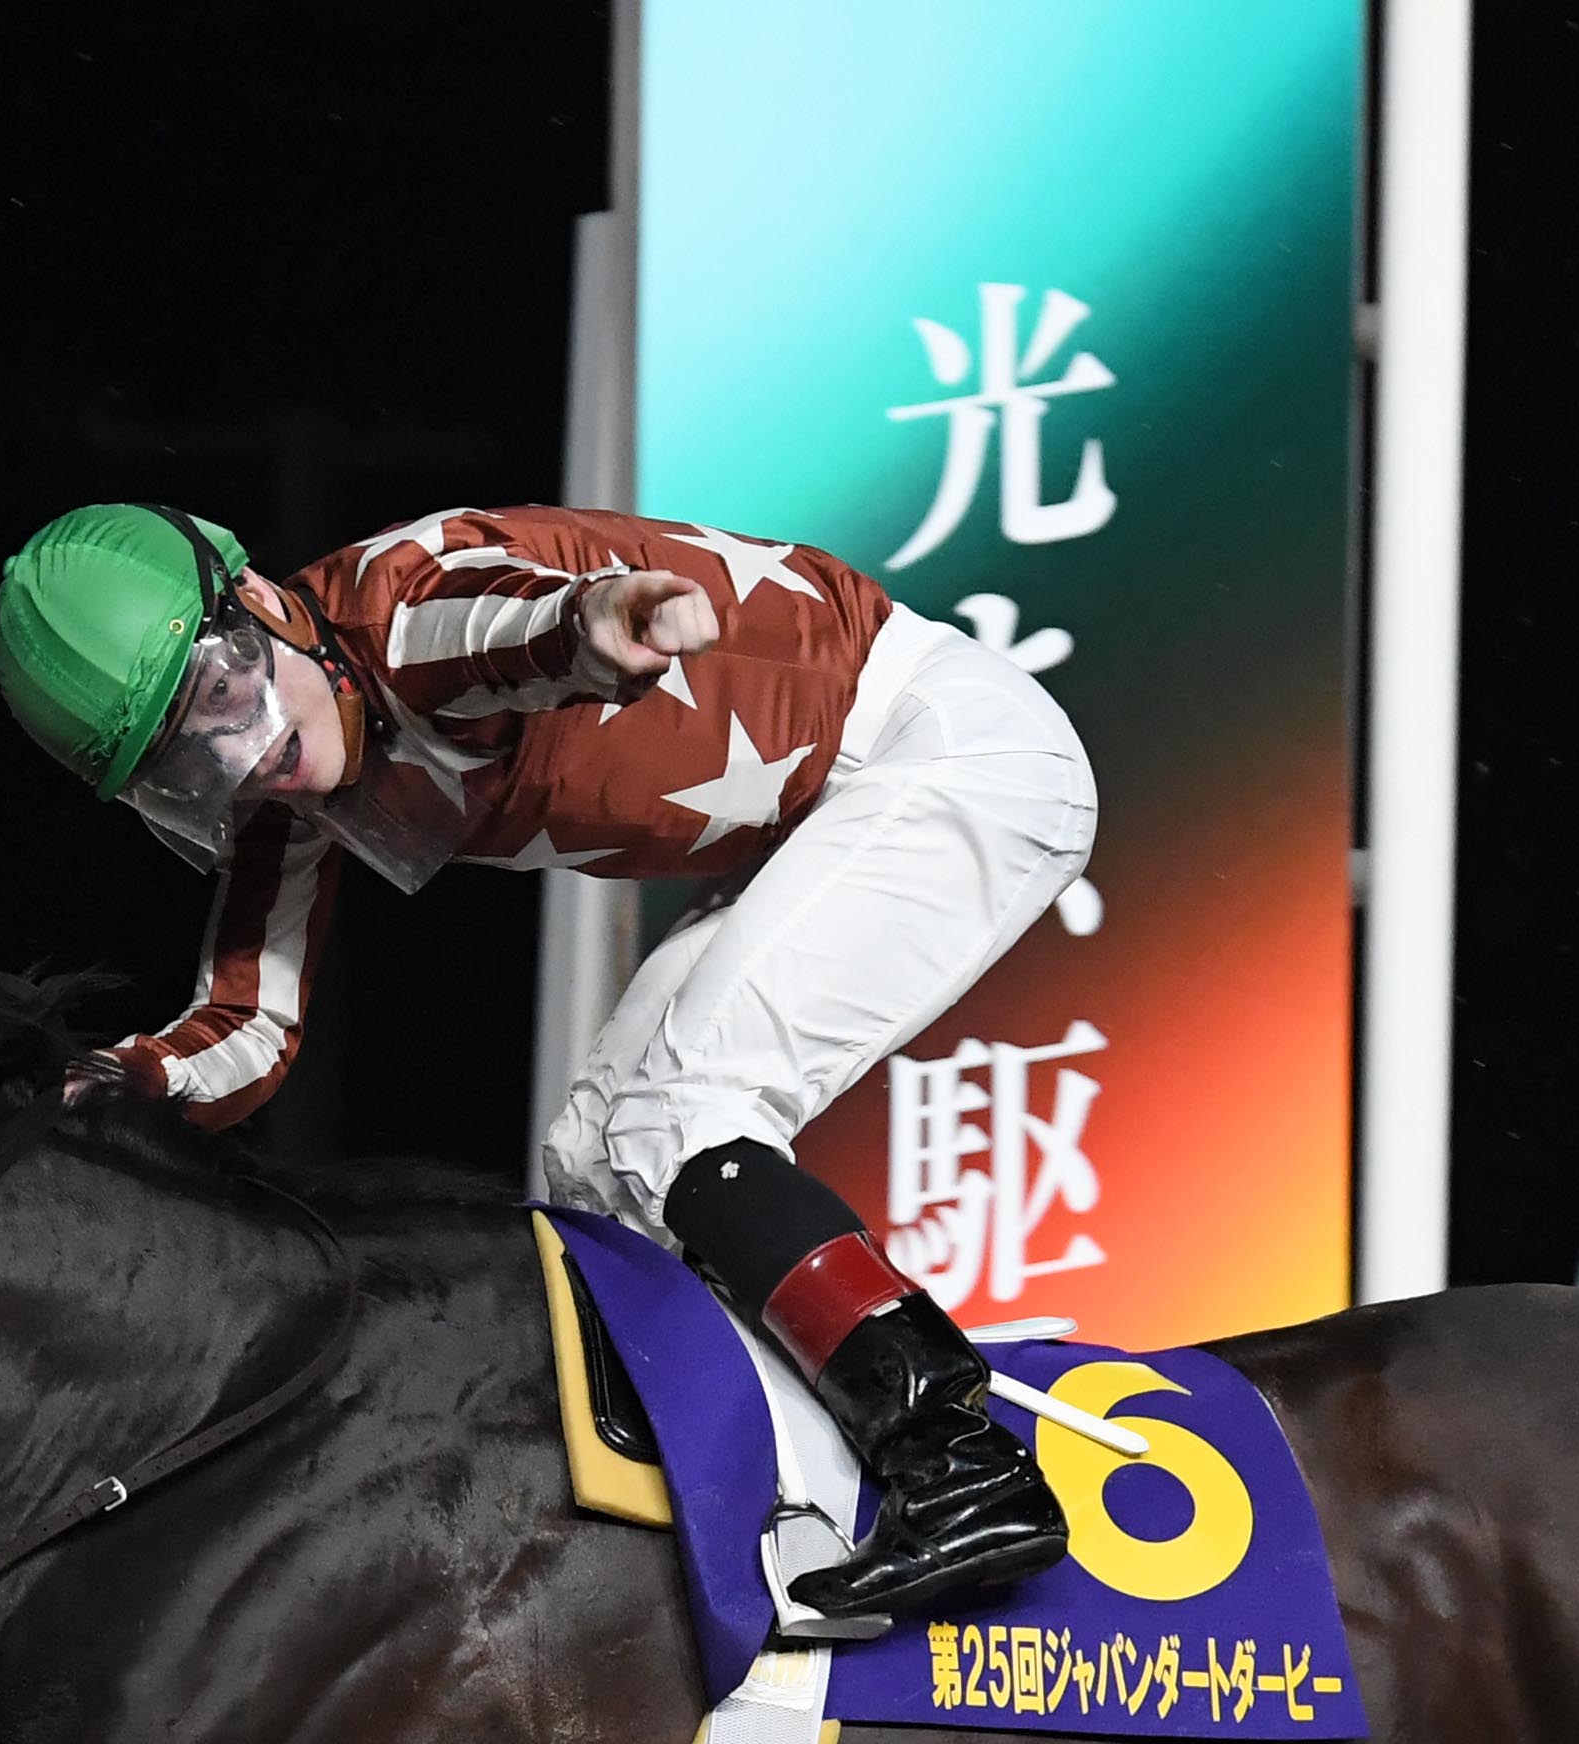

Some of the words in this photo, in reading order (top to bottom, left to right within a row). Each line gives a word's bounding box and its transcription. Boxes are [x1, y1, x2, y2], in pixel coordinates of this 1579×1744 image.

[1033, 1360, 1256, 1602] 6
[926, 1619, 1344, 1724] 第25回ジャパンダートダービー
